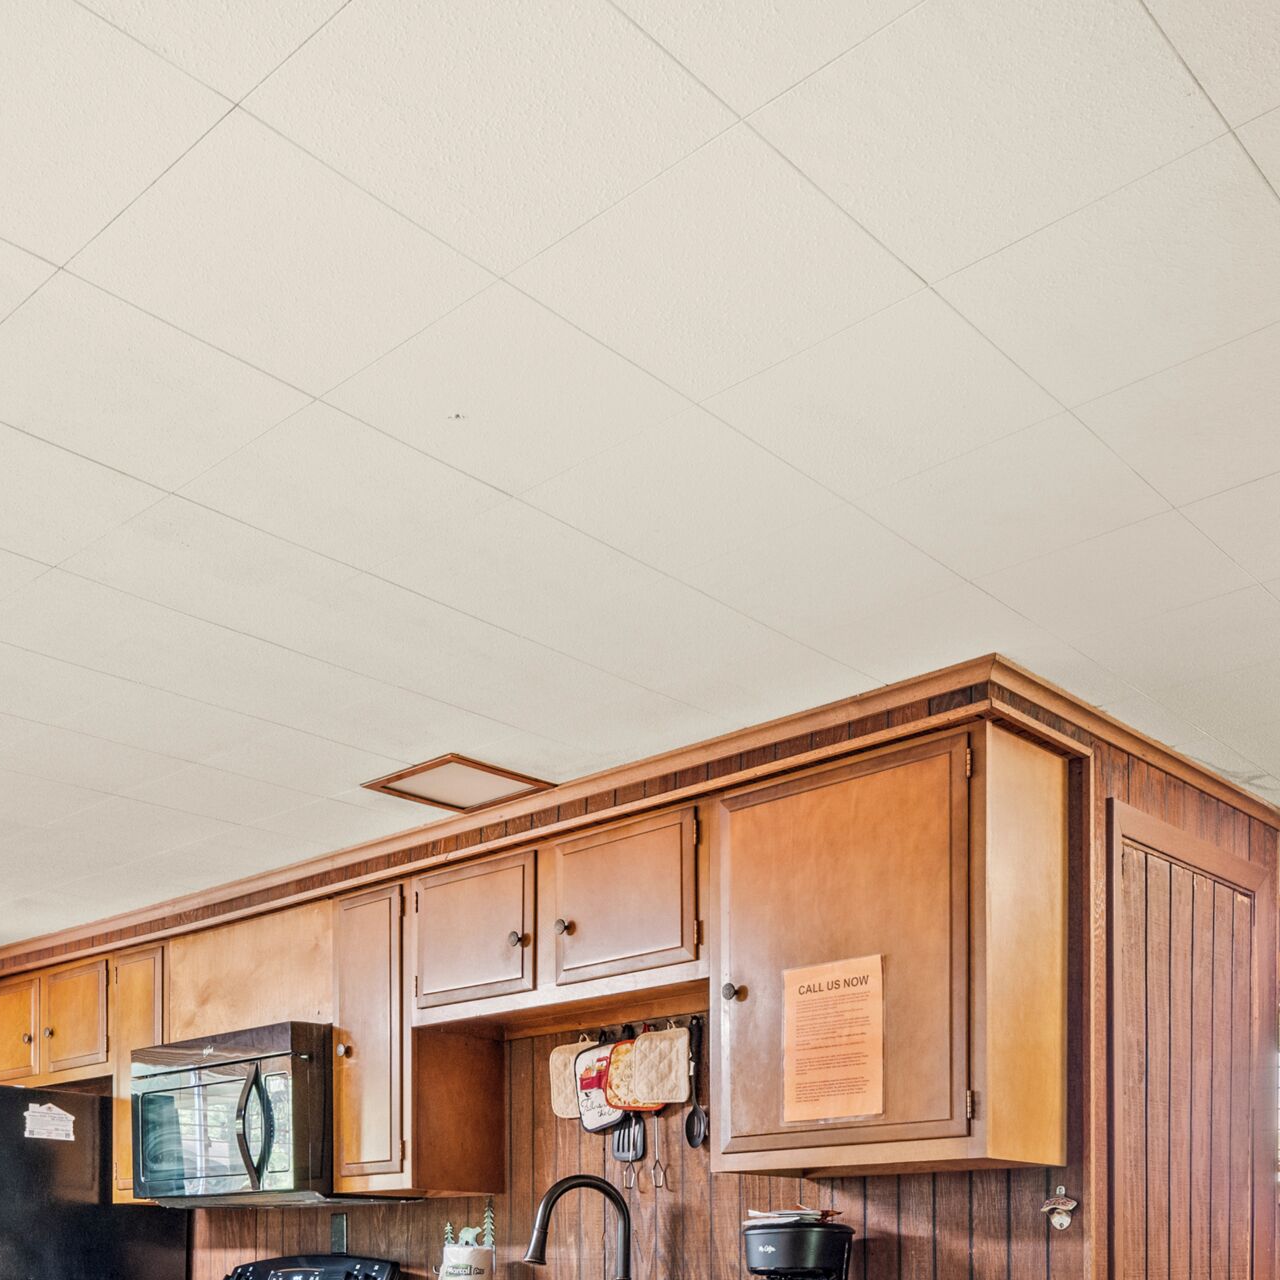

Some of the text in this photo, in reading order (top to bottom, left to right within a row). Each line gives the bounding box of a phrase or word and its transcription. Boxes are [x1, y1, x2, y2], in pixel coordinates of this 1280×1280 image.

[798, 974, 870, 995] CALL US NOW
